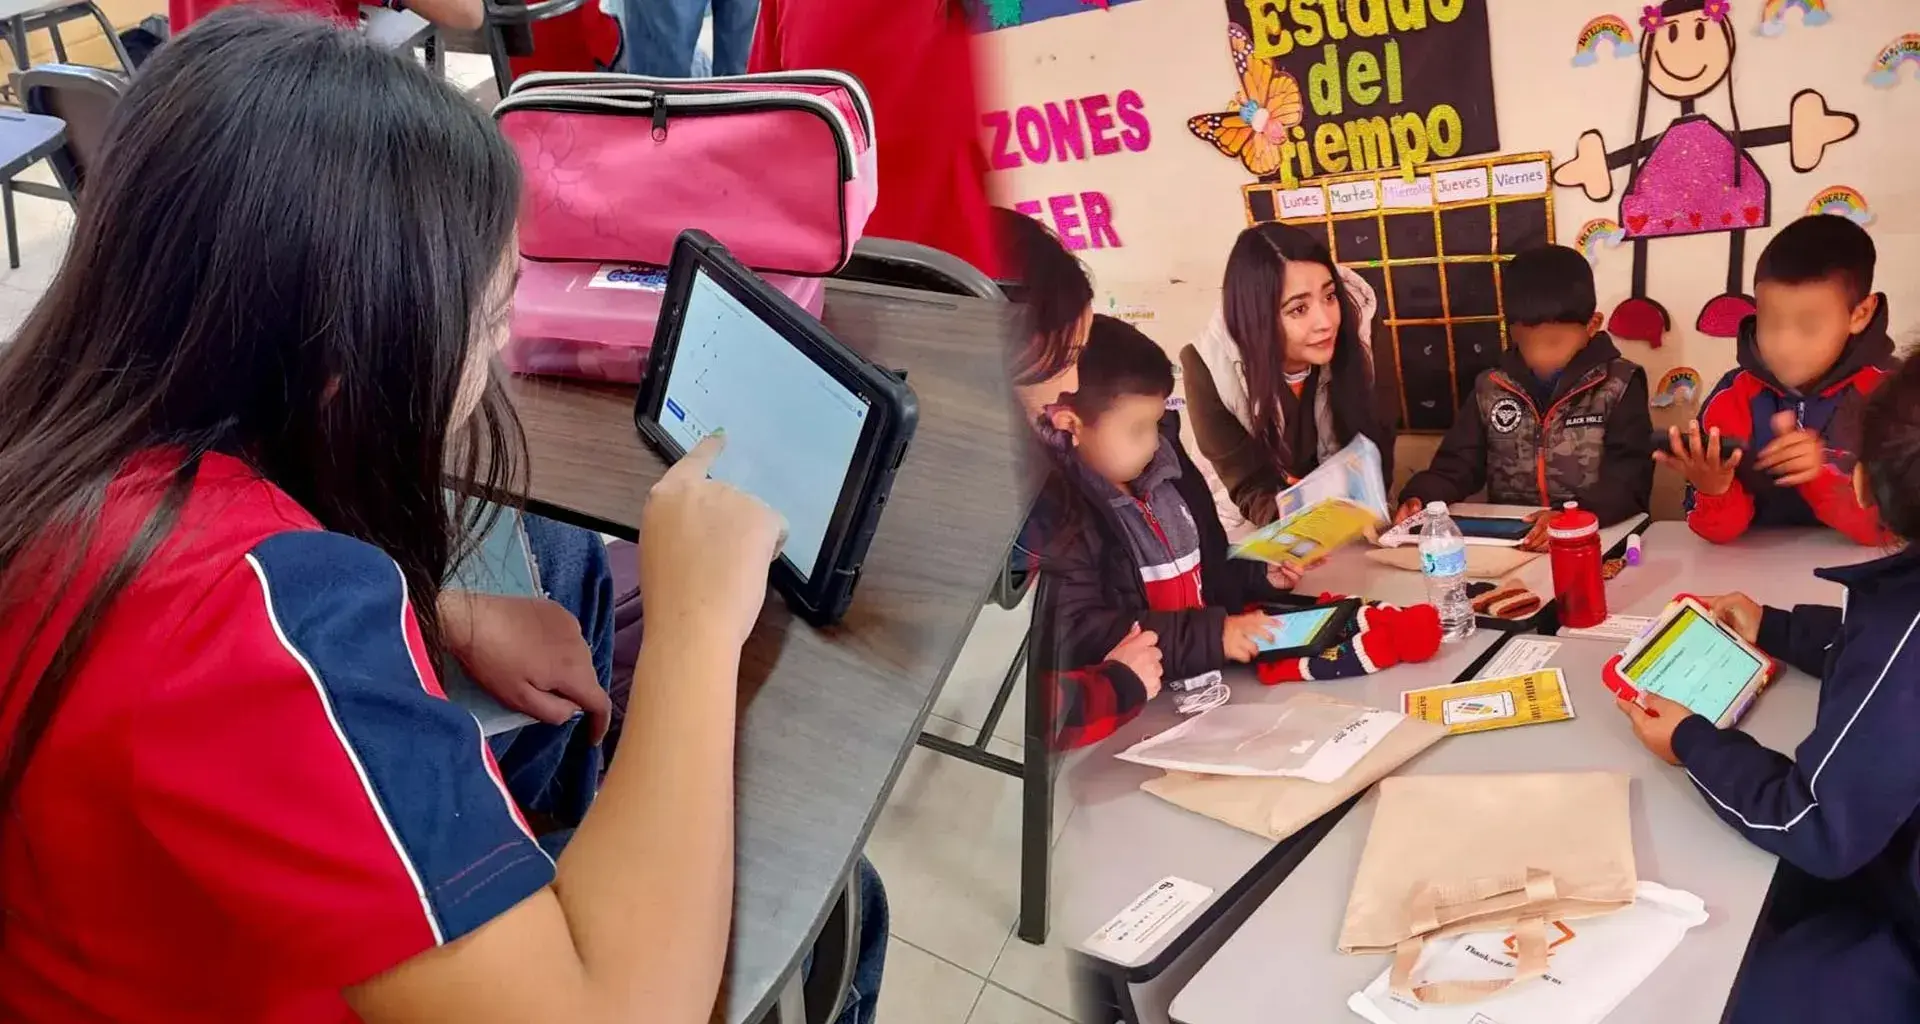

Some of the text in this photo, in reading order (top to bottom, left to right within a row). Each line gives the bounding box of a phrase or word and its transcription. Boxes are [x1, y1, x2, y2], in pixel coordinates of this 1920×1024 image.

[1308, 37, 1403, 116] del
[974, 88, 1152, 171] ZONES
[1281, 194, 1320, 210] Lunes
[1330, 183, 1375, 204] Martes
[1438, 175, 1481, 194] Jueves
[1494, 170, 1544, 188] Viernes
[1566, 415, 1603, 426] BLACK HOLE
[1464, 944, 1490, 962] Thank
